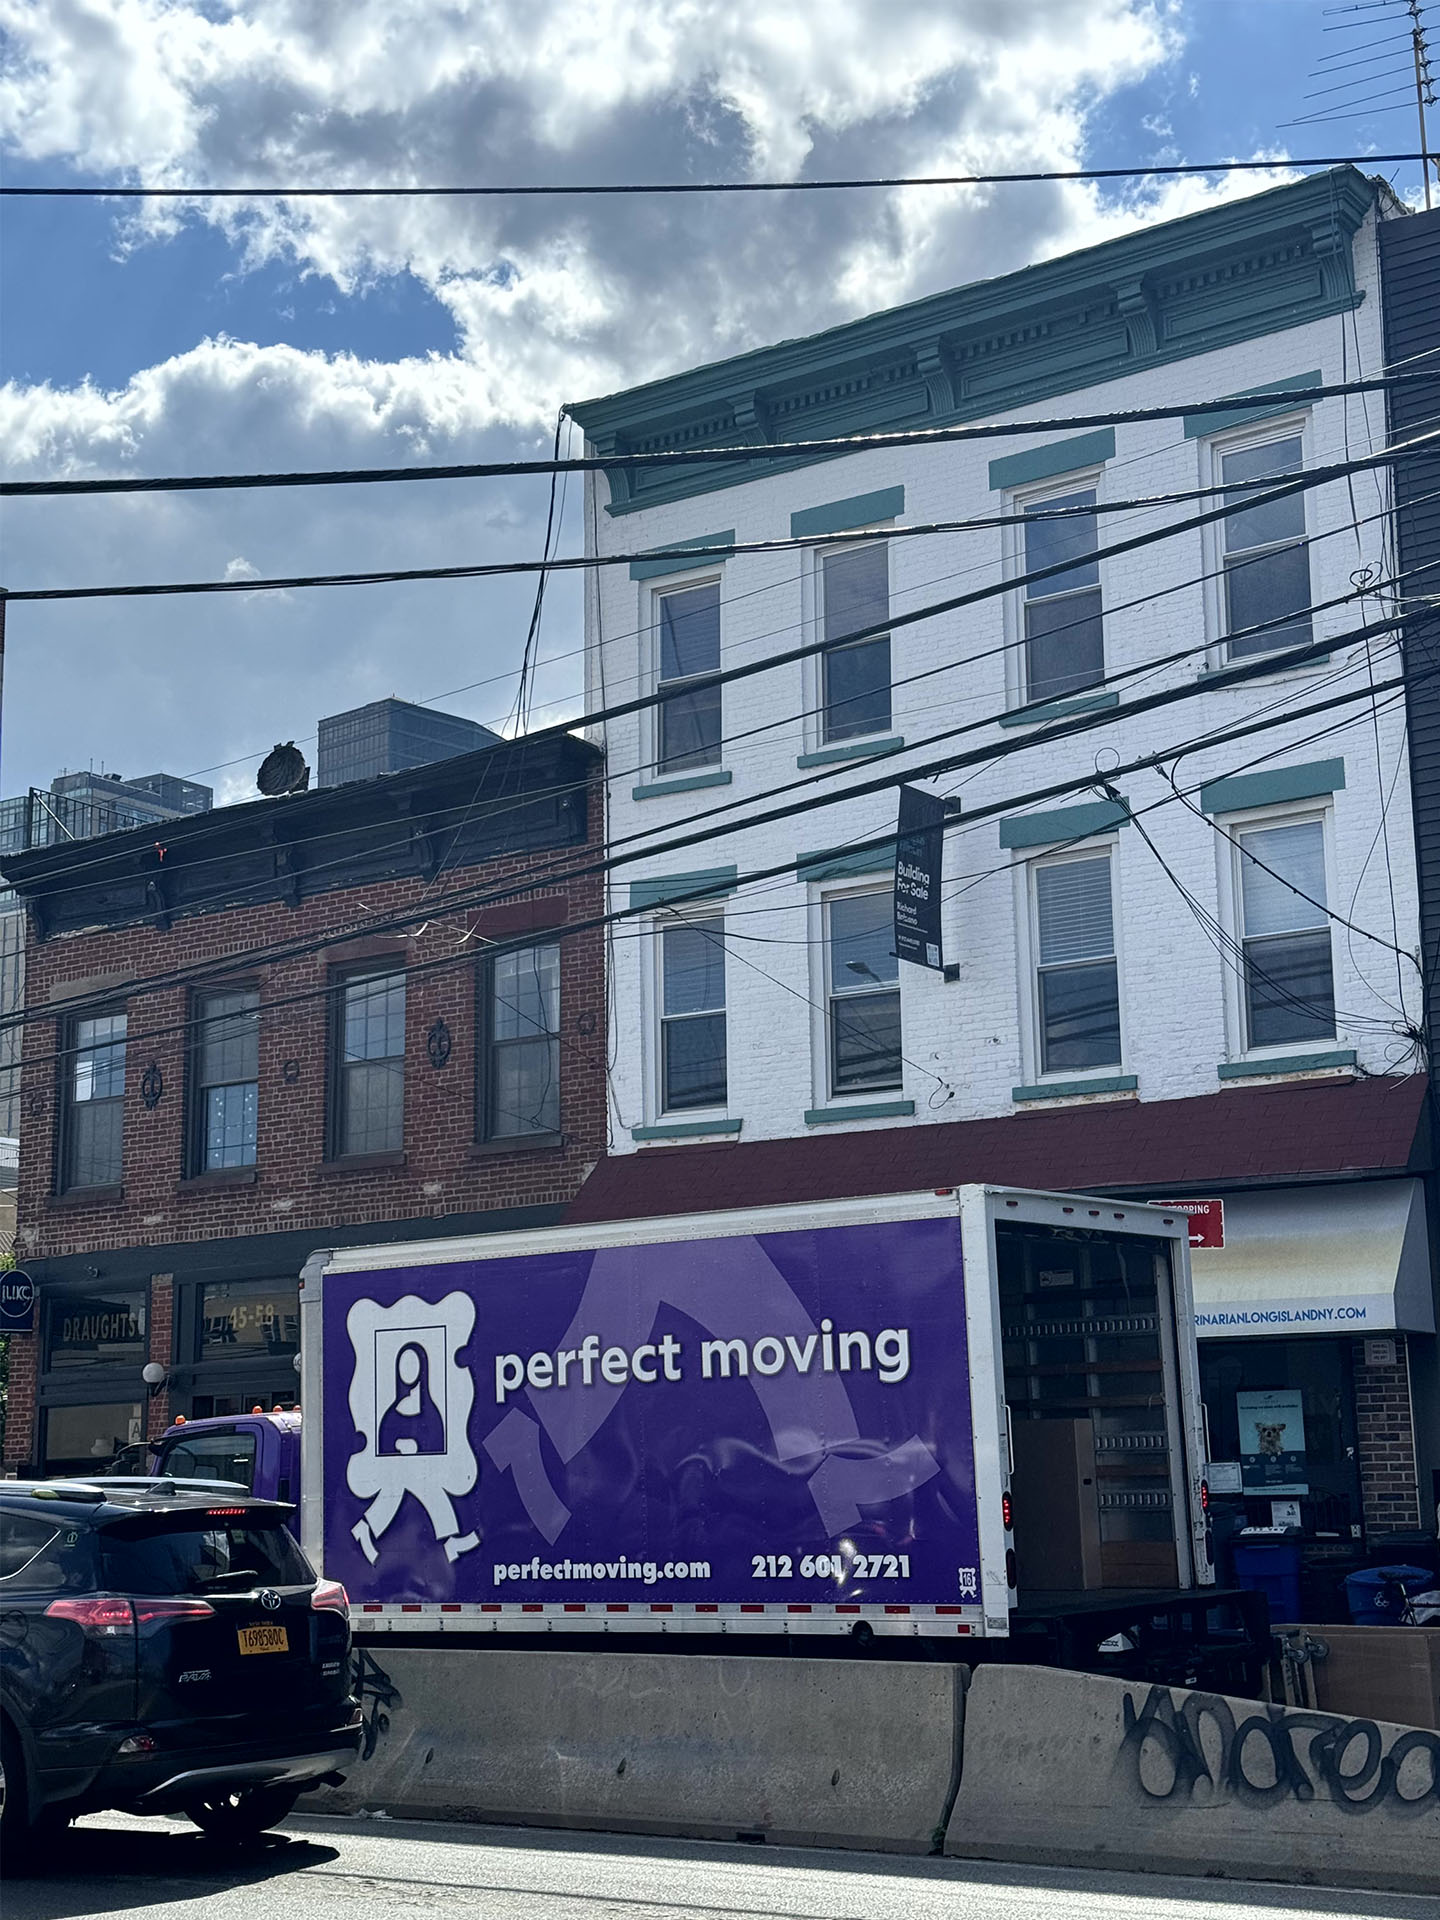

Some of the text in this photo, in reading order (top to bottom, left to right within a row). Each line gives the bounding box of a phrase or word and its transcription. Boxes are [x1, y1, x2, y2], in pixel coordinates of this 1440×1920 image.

[898, 861, 930, 888] Building
[897, 877, 929, 900] For Sale
[63, 1312, 136, 1342] DRAUGHTS
[229, 1304, 274, 1329] 45-58
[494, 1318, 911, 1404] perfect moving
[493, 1555, 711, 1585] perfectmoving.com
[751, 1554, 910, 1579] 212 601 2721
[962, 1573, 972, 1586] 16
